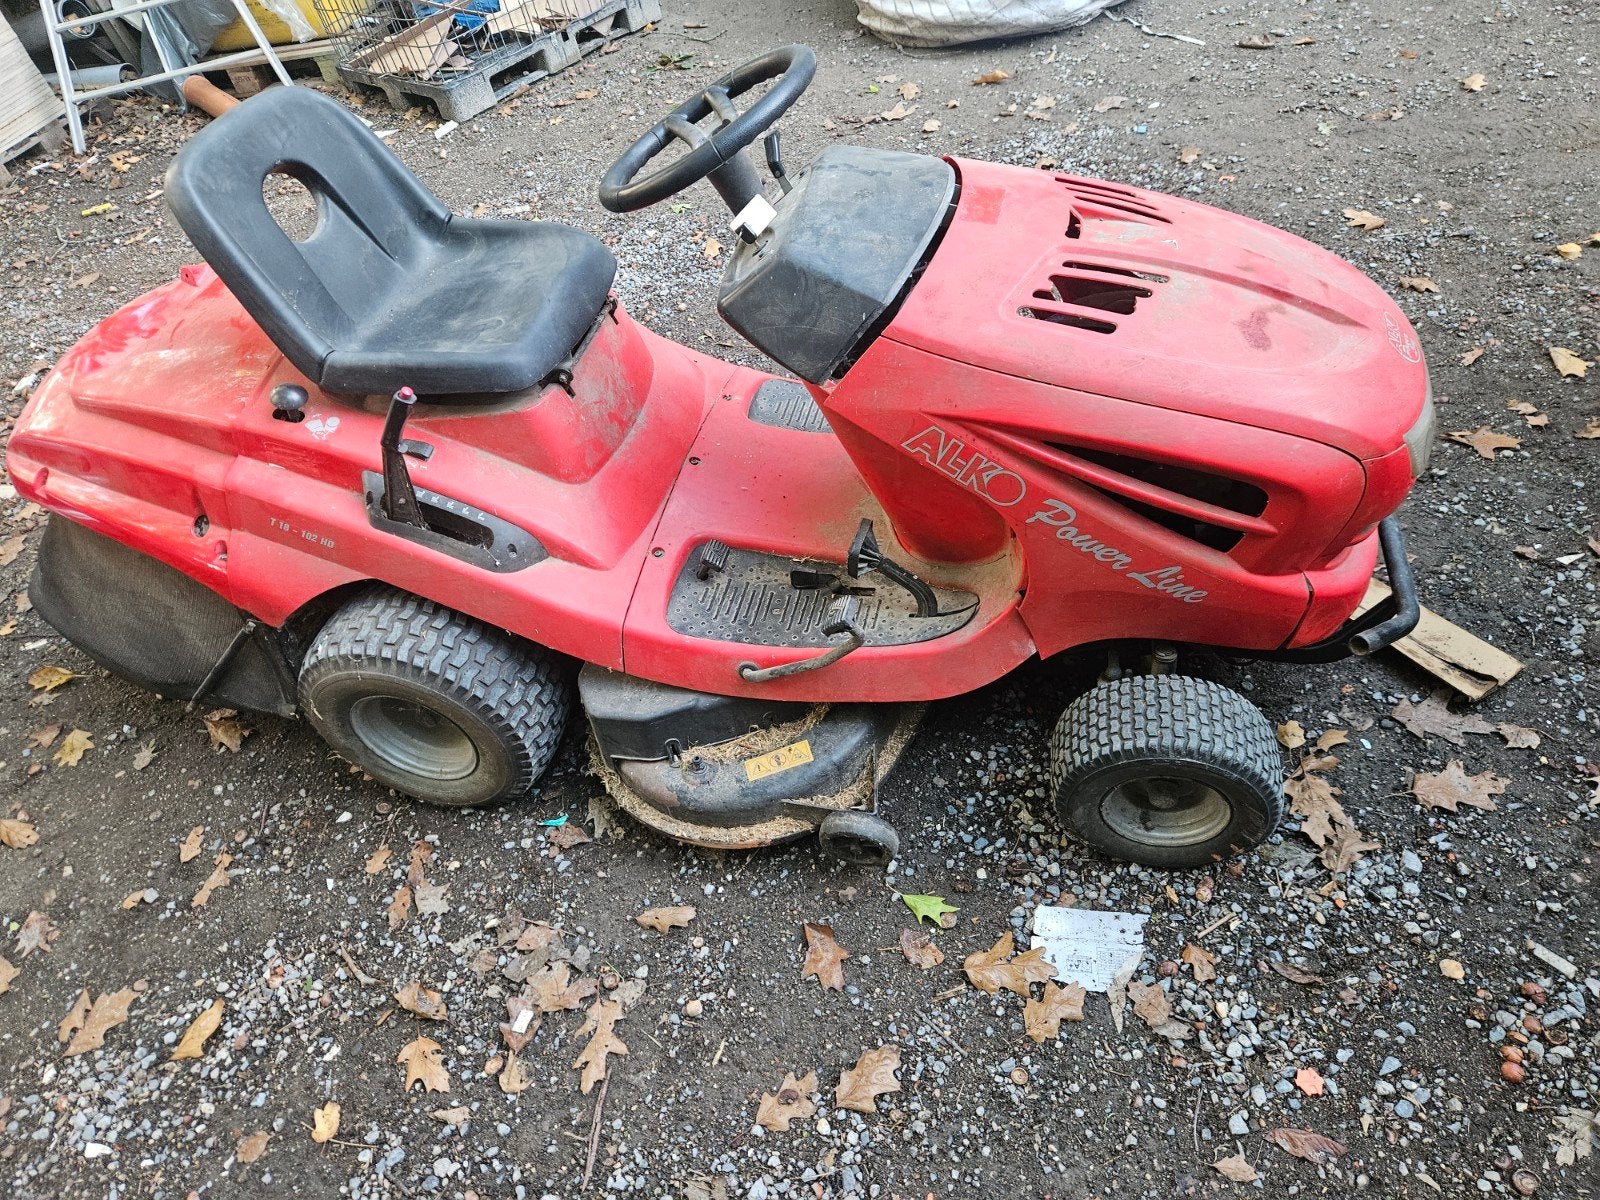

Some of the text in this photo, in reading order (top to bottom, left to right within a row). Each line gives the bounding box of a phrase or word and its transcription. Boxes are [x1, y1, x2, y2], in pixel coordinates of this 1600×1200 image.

[270, 517, 276, 527] T
[301, 530, 318, 543] 102
[901, 425, 1209, 604] AL-KO Power Line
